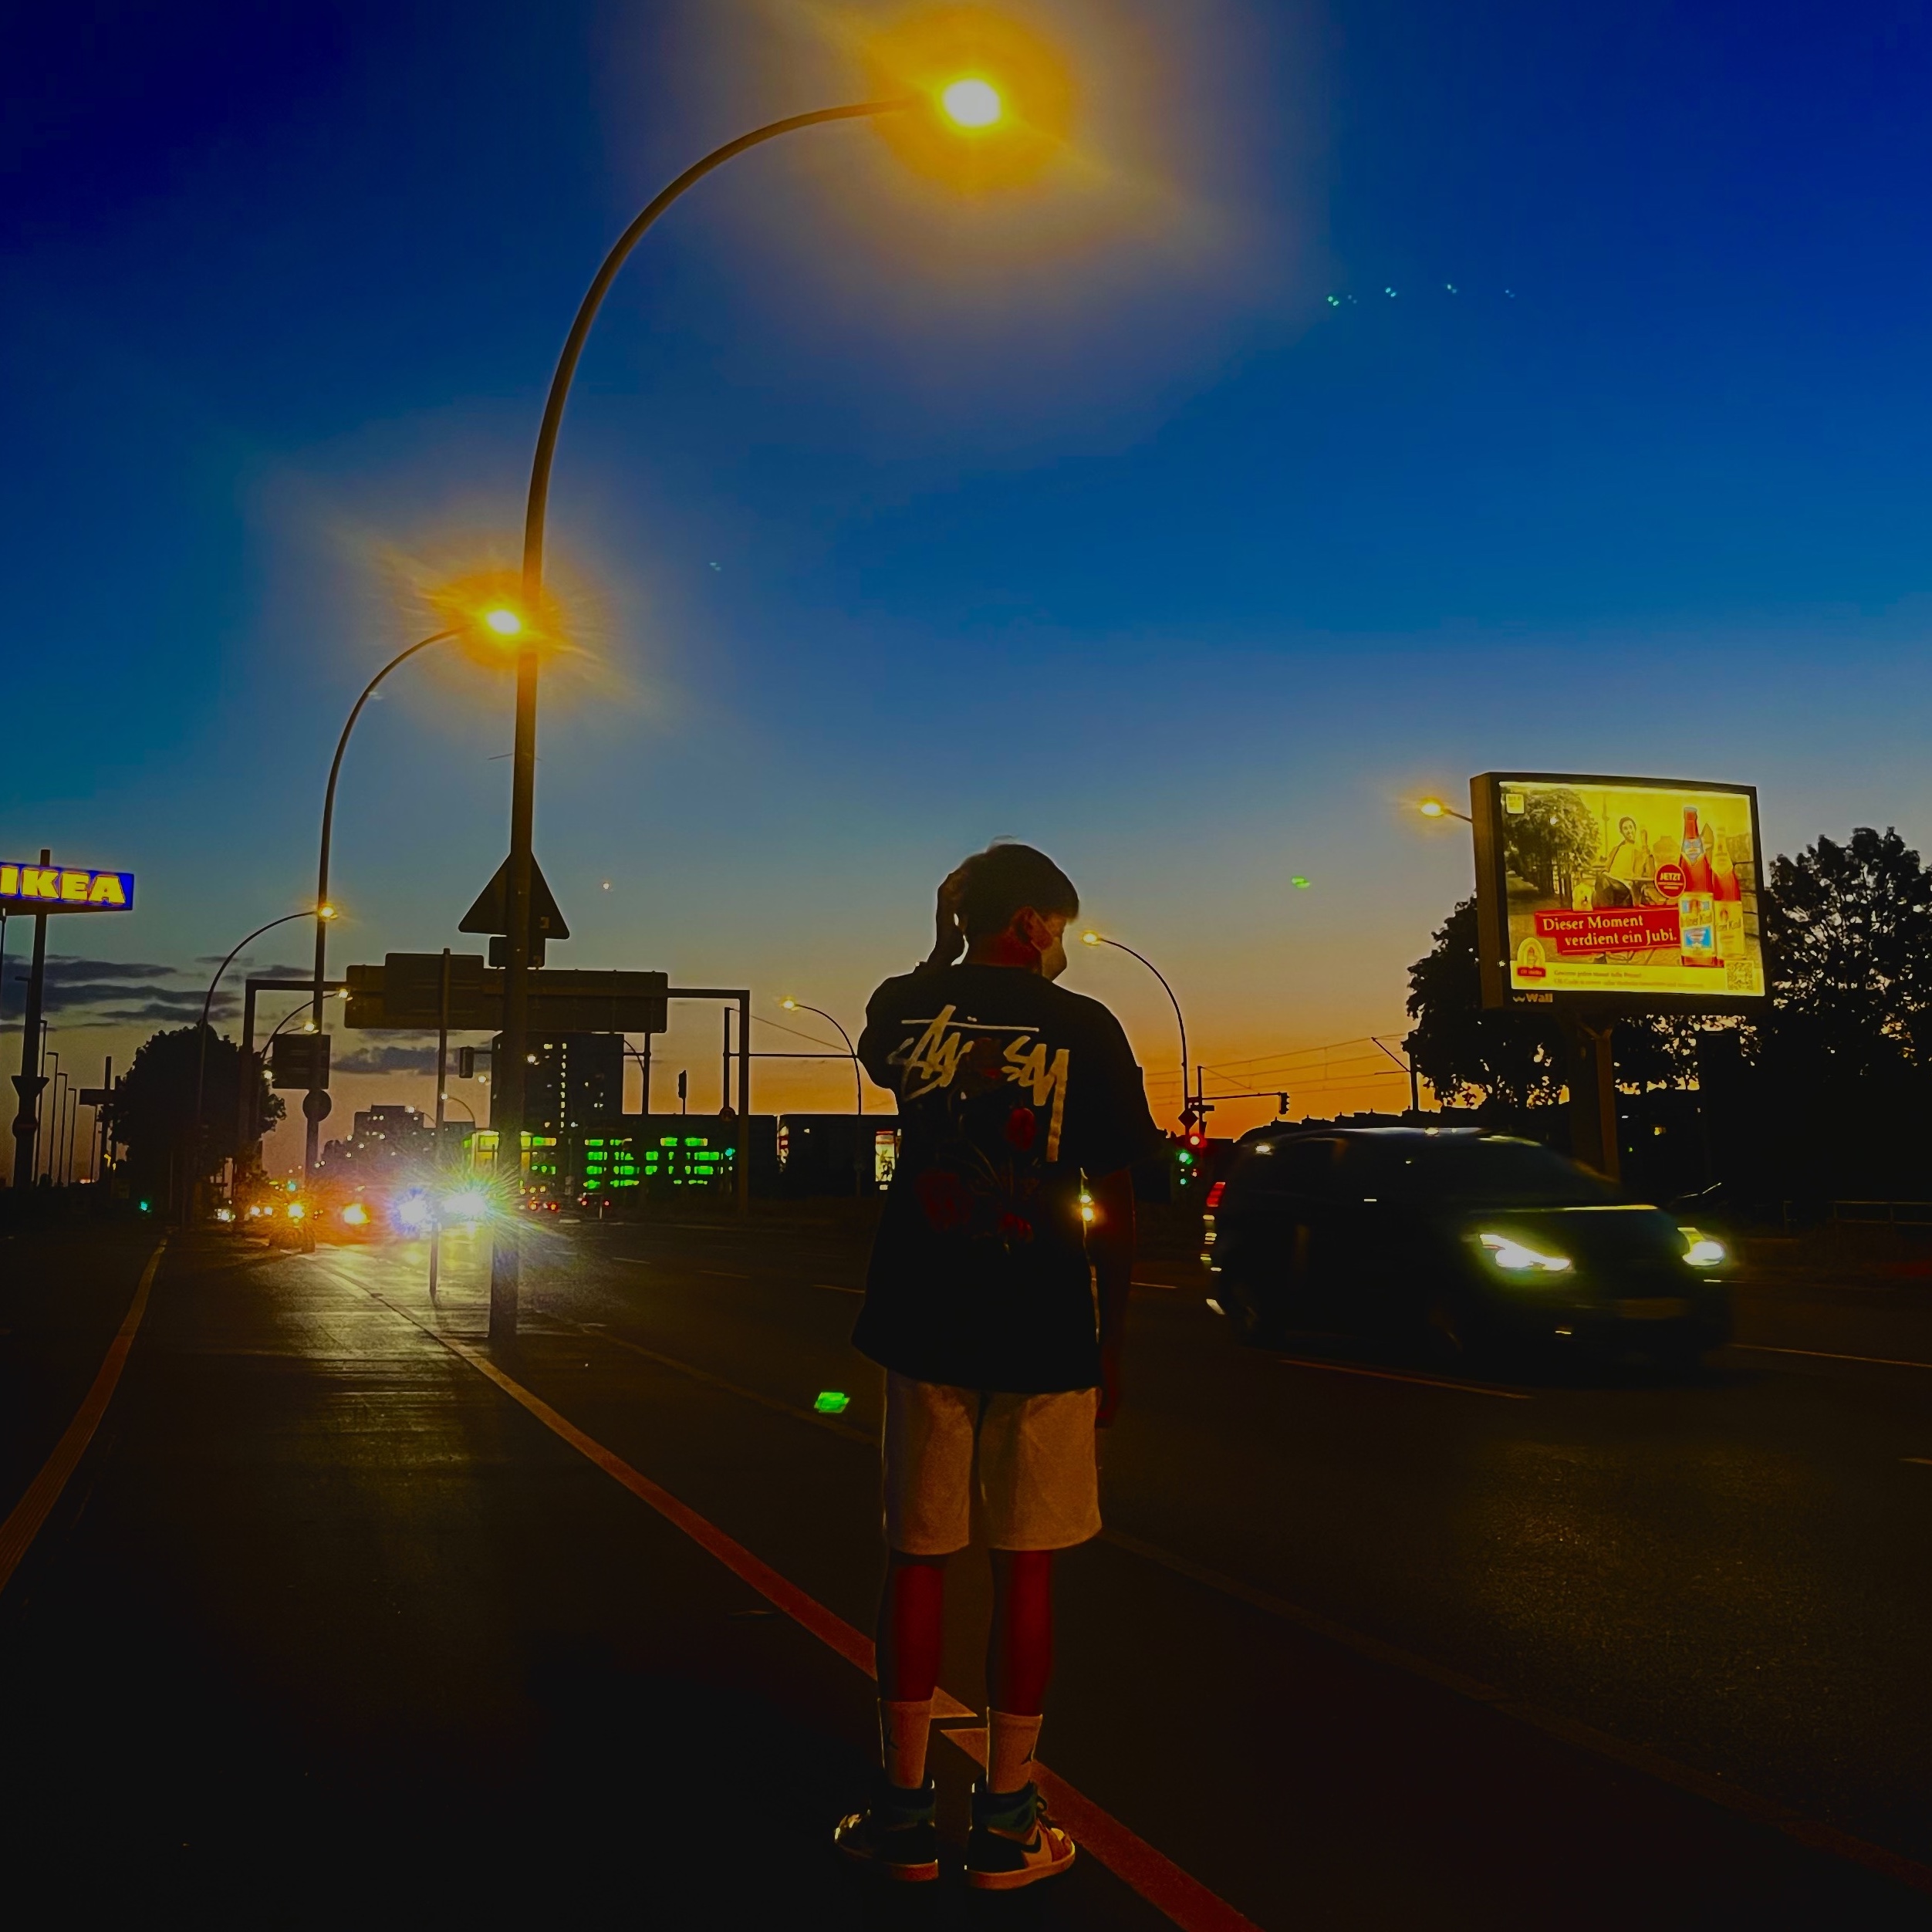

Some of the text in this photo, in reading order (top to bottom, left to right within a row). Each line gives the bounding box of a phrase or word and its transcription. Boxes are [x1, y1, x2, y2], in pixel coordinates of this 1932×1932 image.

[0, 865, 127, 905] IKEA
[1660, 872, 1681, 881] JETZT
[1542, 915, 1643, 931] Dieser Moment
[1565, 932, 1620, 946] verdient
[1622, 931, 1643, 944] ein
[1646, 928, 1677, 946] Jubi.
